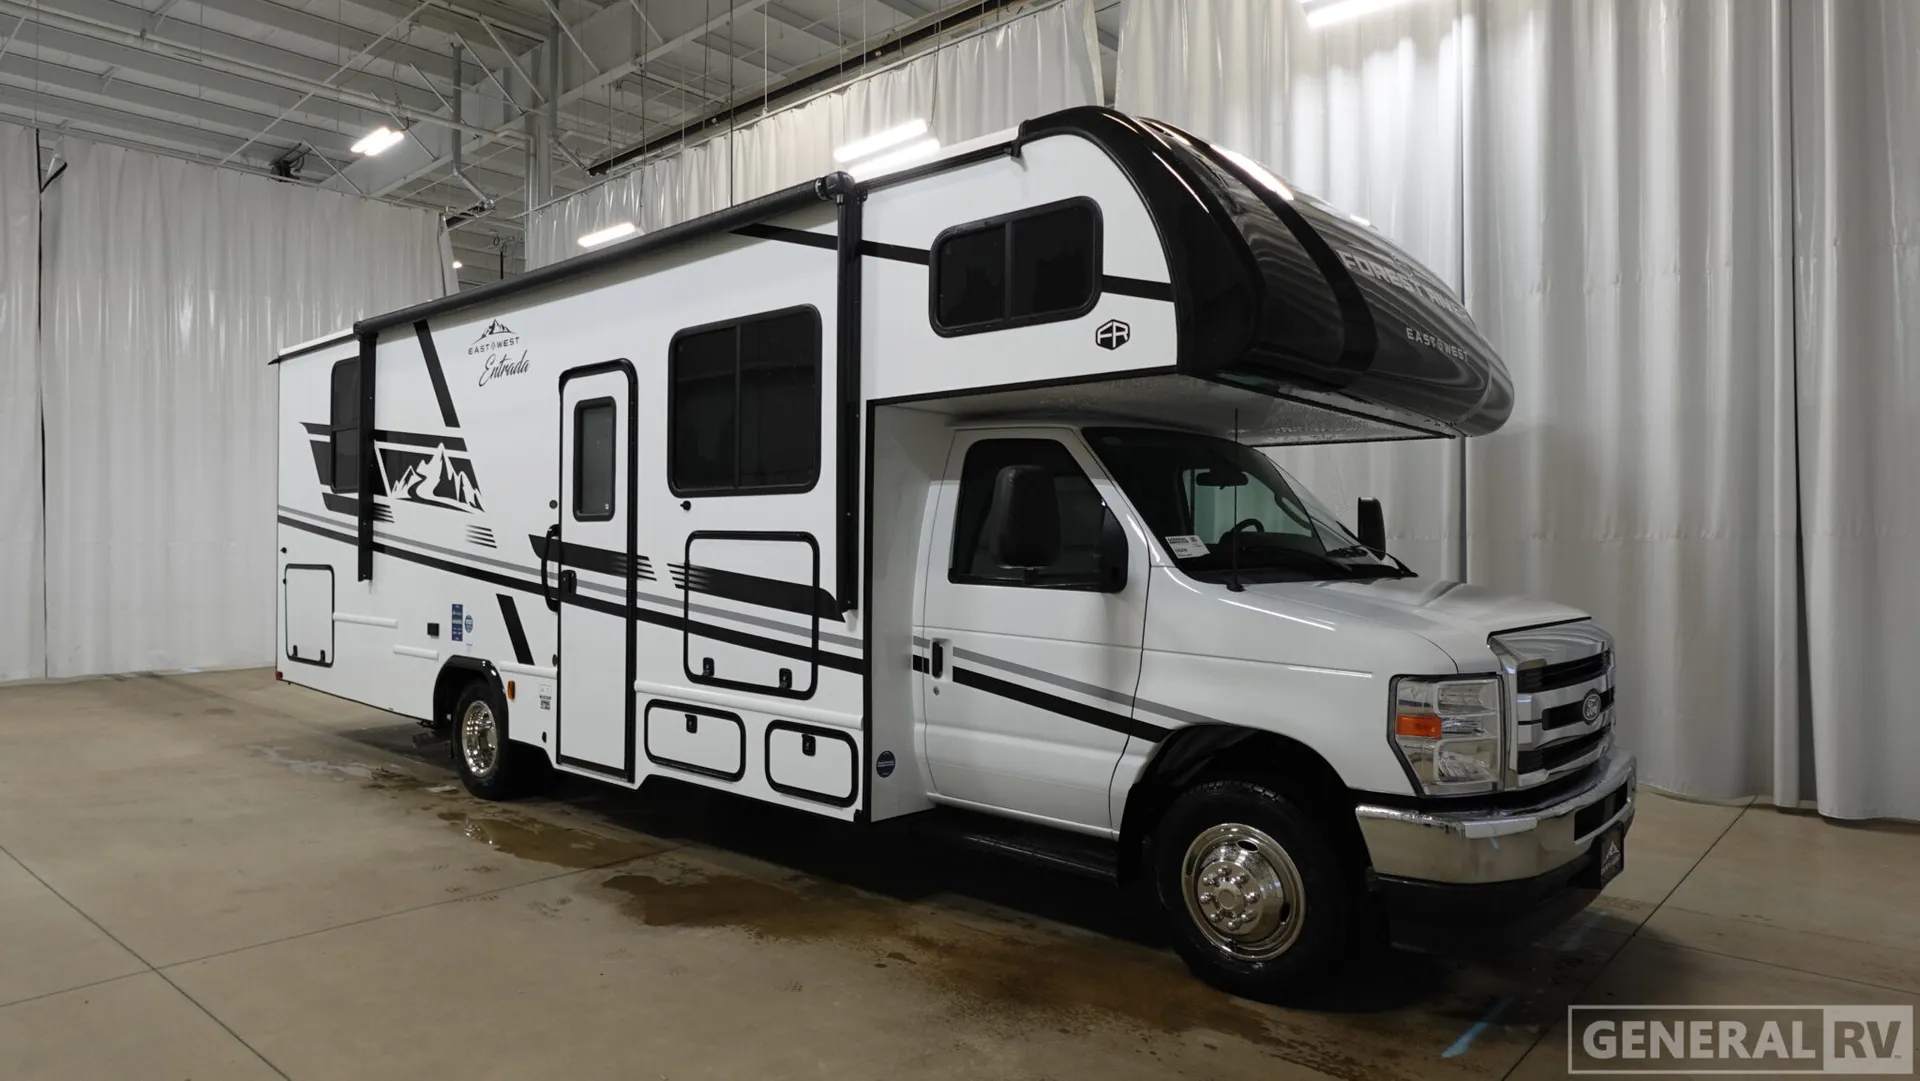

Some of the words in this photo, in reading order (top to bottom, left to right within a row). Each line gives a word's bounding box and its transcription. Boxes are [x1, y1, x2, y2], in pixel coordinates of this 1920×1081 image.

[1335, 249, 1423, 297] FOREST
[468, 343, 490, 355] EAST
[496, 336, 520, 349] WEST
[1406, 327, 1436, 348] EAST
[478, 349, 530, 387] Entrada
